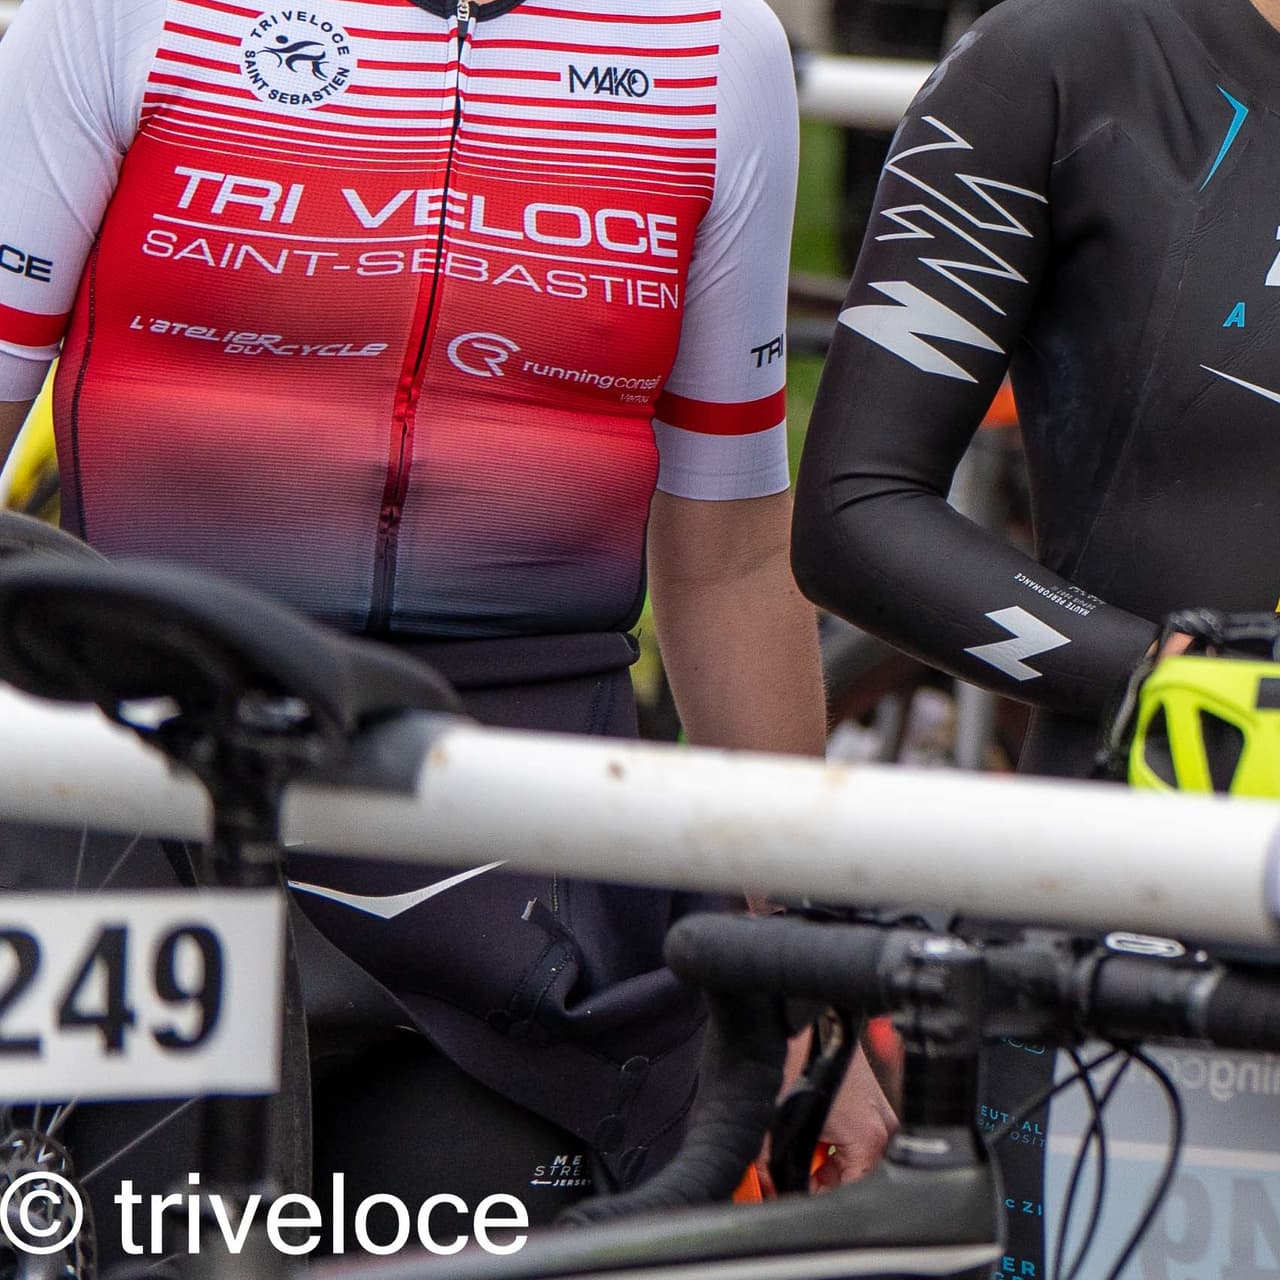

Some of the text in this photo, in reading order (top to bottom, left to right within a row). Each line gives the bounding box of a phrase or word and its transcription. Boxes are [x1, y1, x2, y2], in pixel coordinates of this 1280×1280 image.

[250, 10, 350, 56] TRI VELOCE
[244, 49, 351, 105] SAINT SEBASTIEN
[568, 64, 649, 97] MAKO
[173, 166, 679, 258] TRI VELOCE
[141, 229, 680, 310] SAINT-SEBASTIEN
[223, 343, 264, 355] DU
[1013, 573, 1068, 607] PERFORMANCE
[0, 923, 224, 1057] 249
